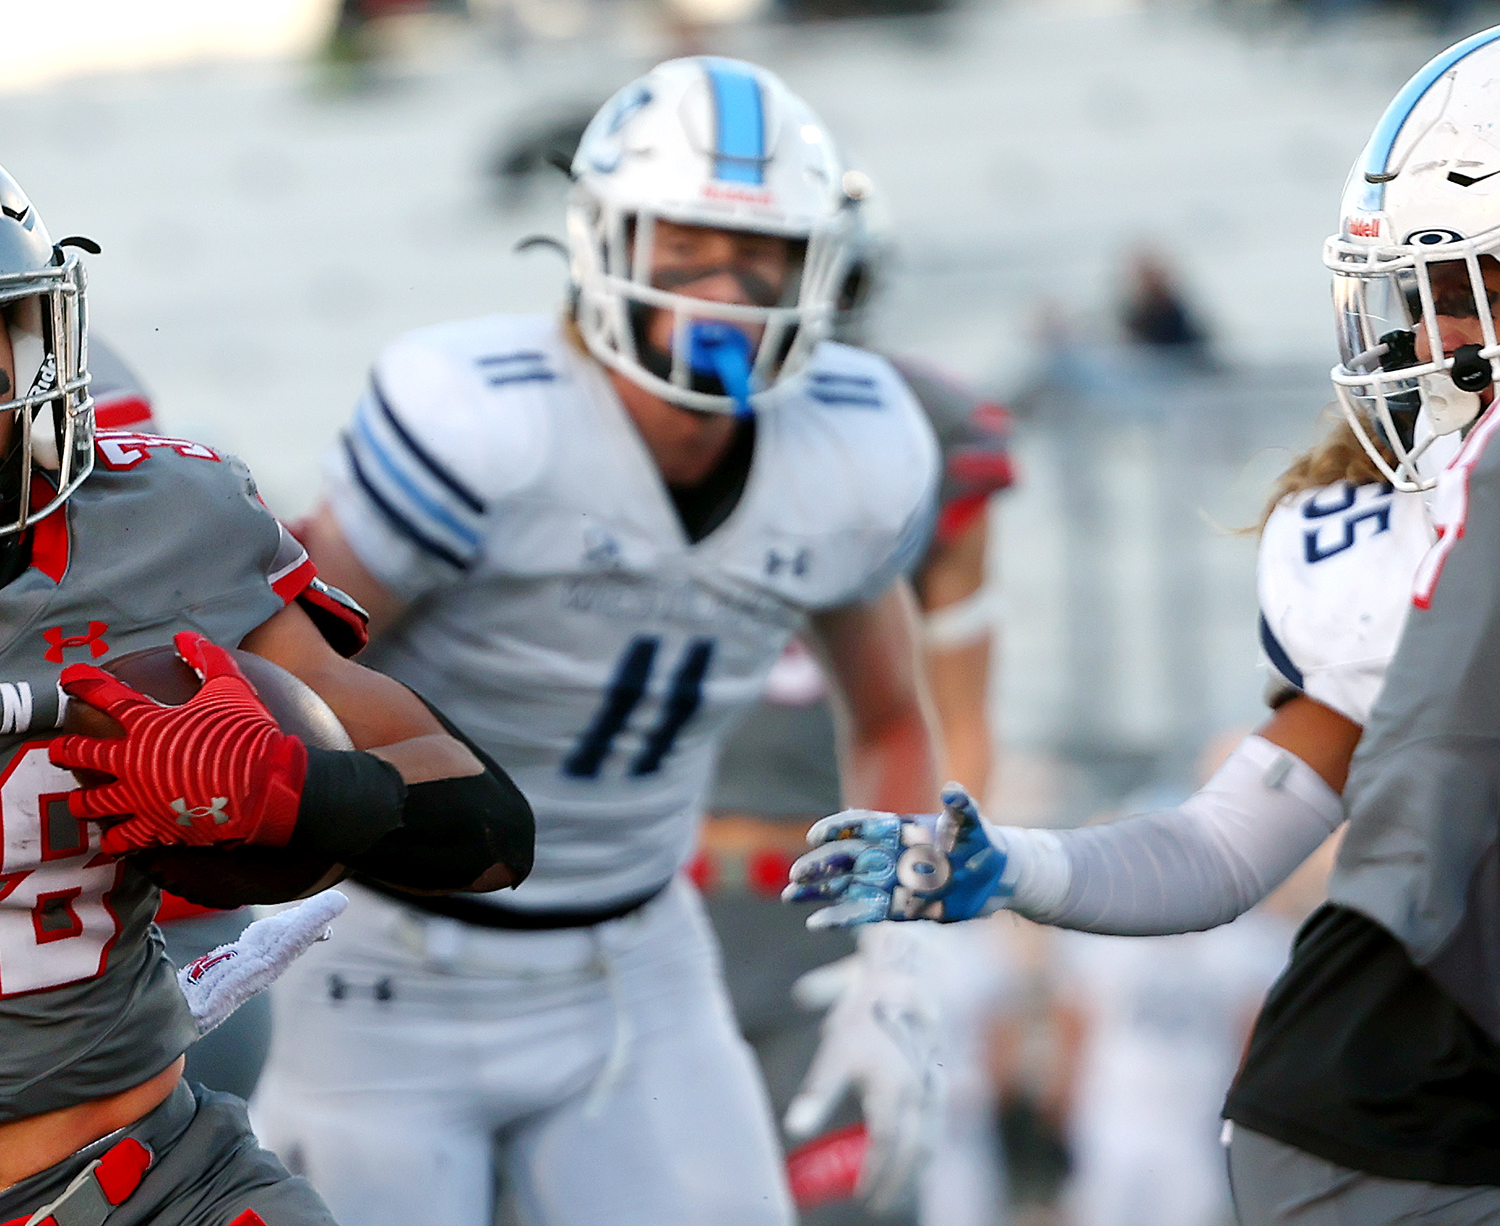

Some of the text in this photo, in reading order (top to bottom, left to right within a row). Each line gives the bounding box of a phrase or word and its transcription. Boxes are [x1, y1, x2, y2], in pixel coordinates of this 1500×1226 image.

[477, 350, 557, 386] 11
[807, 371, 884, 408] 11
[562, 635, 715, 778] 11
